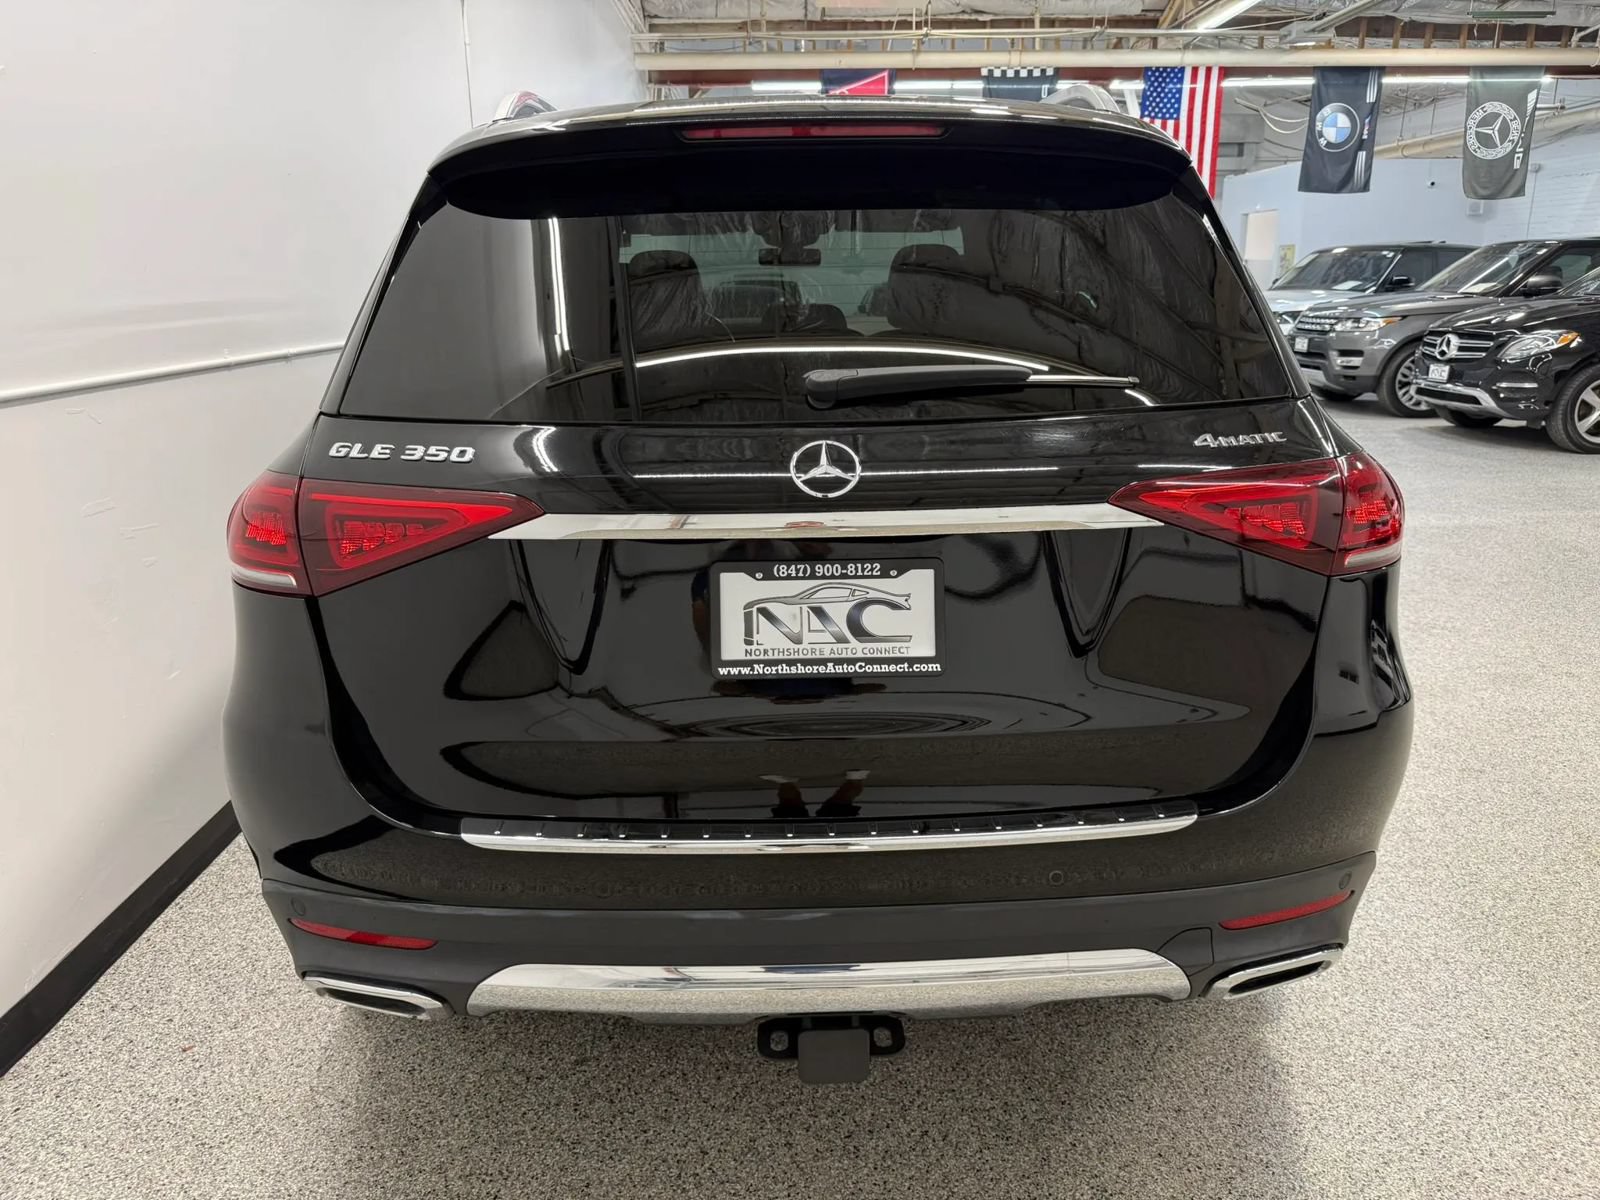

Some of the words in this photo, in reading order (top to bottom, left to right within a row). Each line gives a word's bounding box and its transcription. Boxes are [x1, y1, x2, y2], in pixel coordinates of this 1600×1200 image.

[1193, 432, 1288, 448] 4MATIC
[328, 442, 396, 460] GLE
[400, 445, 476, 463] 350
[773, 564, 811, 578] (847)
[815, 563, 881, 577] 900-8122
[743, 599, 912, 646] NAC
[744, 647, 825, 658] NORTHSHORE
[829, 646, 858, 657] AUTO
[861, 646, 911, 656] CONNECT
[718, 661, 942, 676] www.NorthshoreAutoConnect.com
